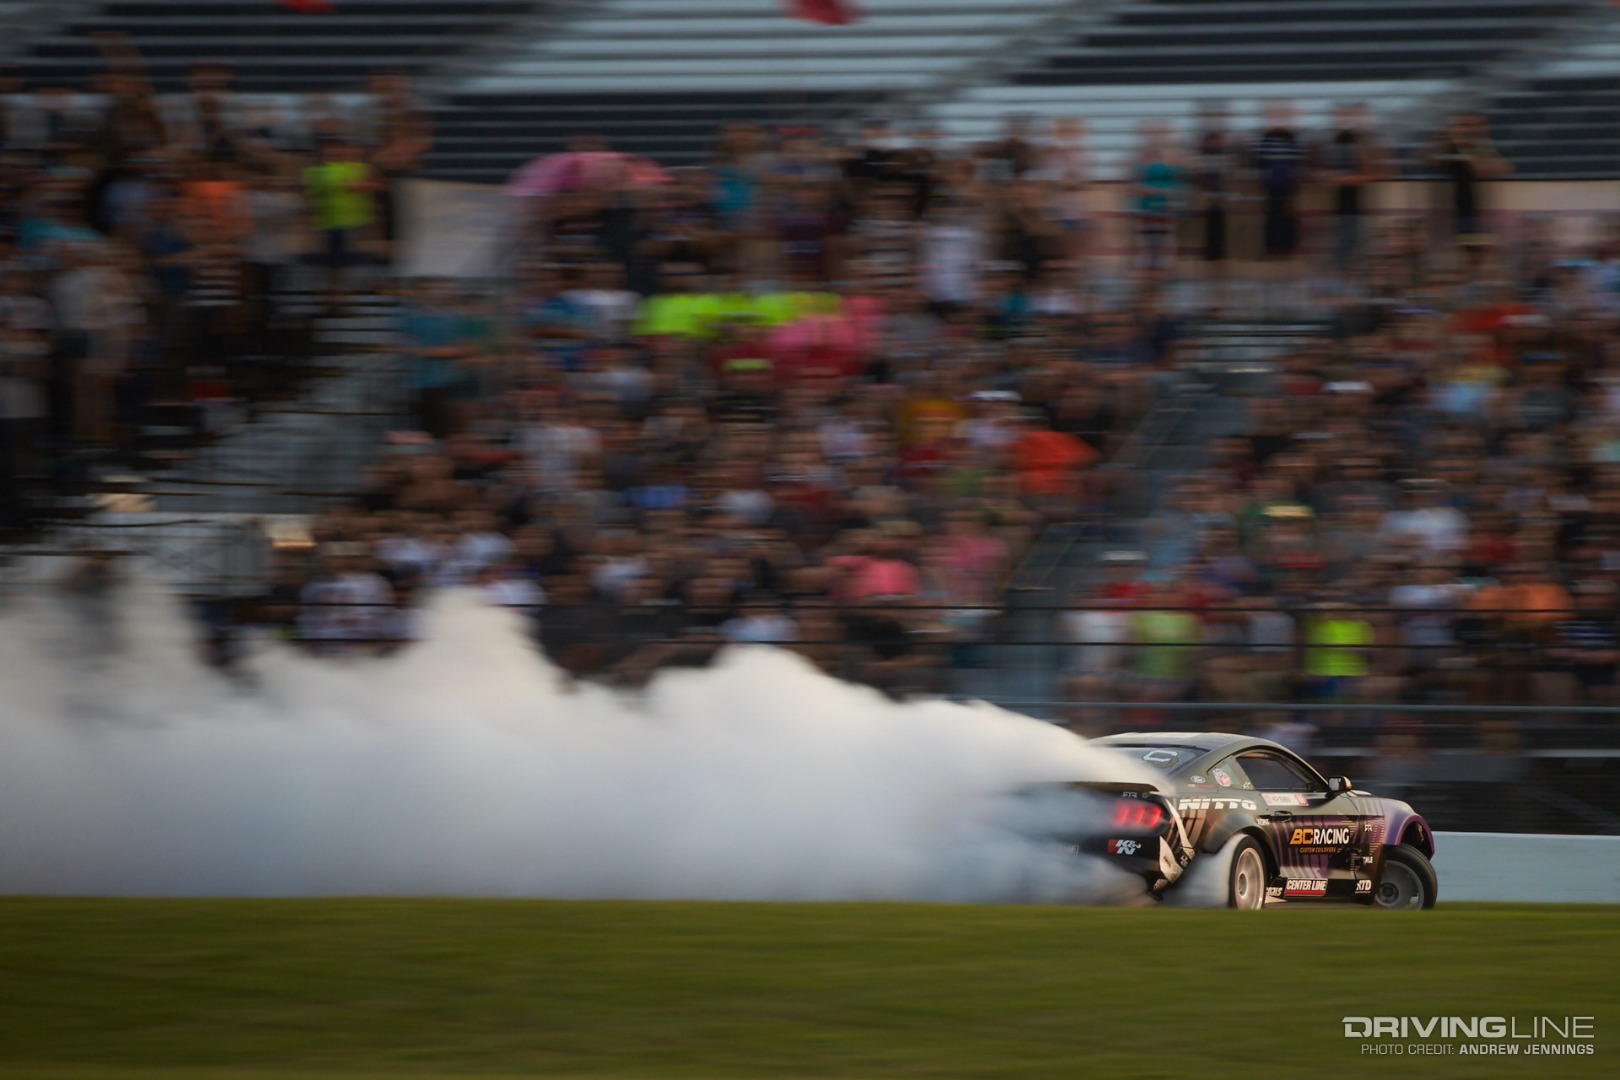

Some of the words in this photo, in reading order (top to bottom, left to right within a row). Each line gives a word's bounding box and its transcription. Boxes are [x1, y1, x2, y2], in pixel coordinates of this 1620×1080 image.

[1178, 797, 1257, 811] NITTO
[1115, 839, 1142, 855] K&N
[1286, 880, 1312, 890] CENTER
[1311, 880, 1328, 890] LINE
